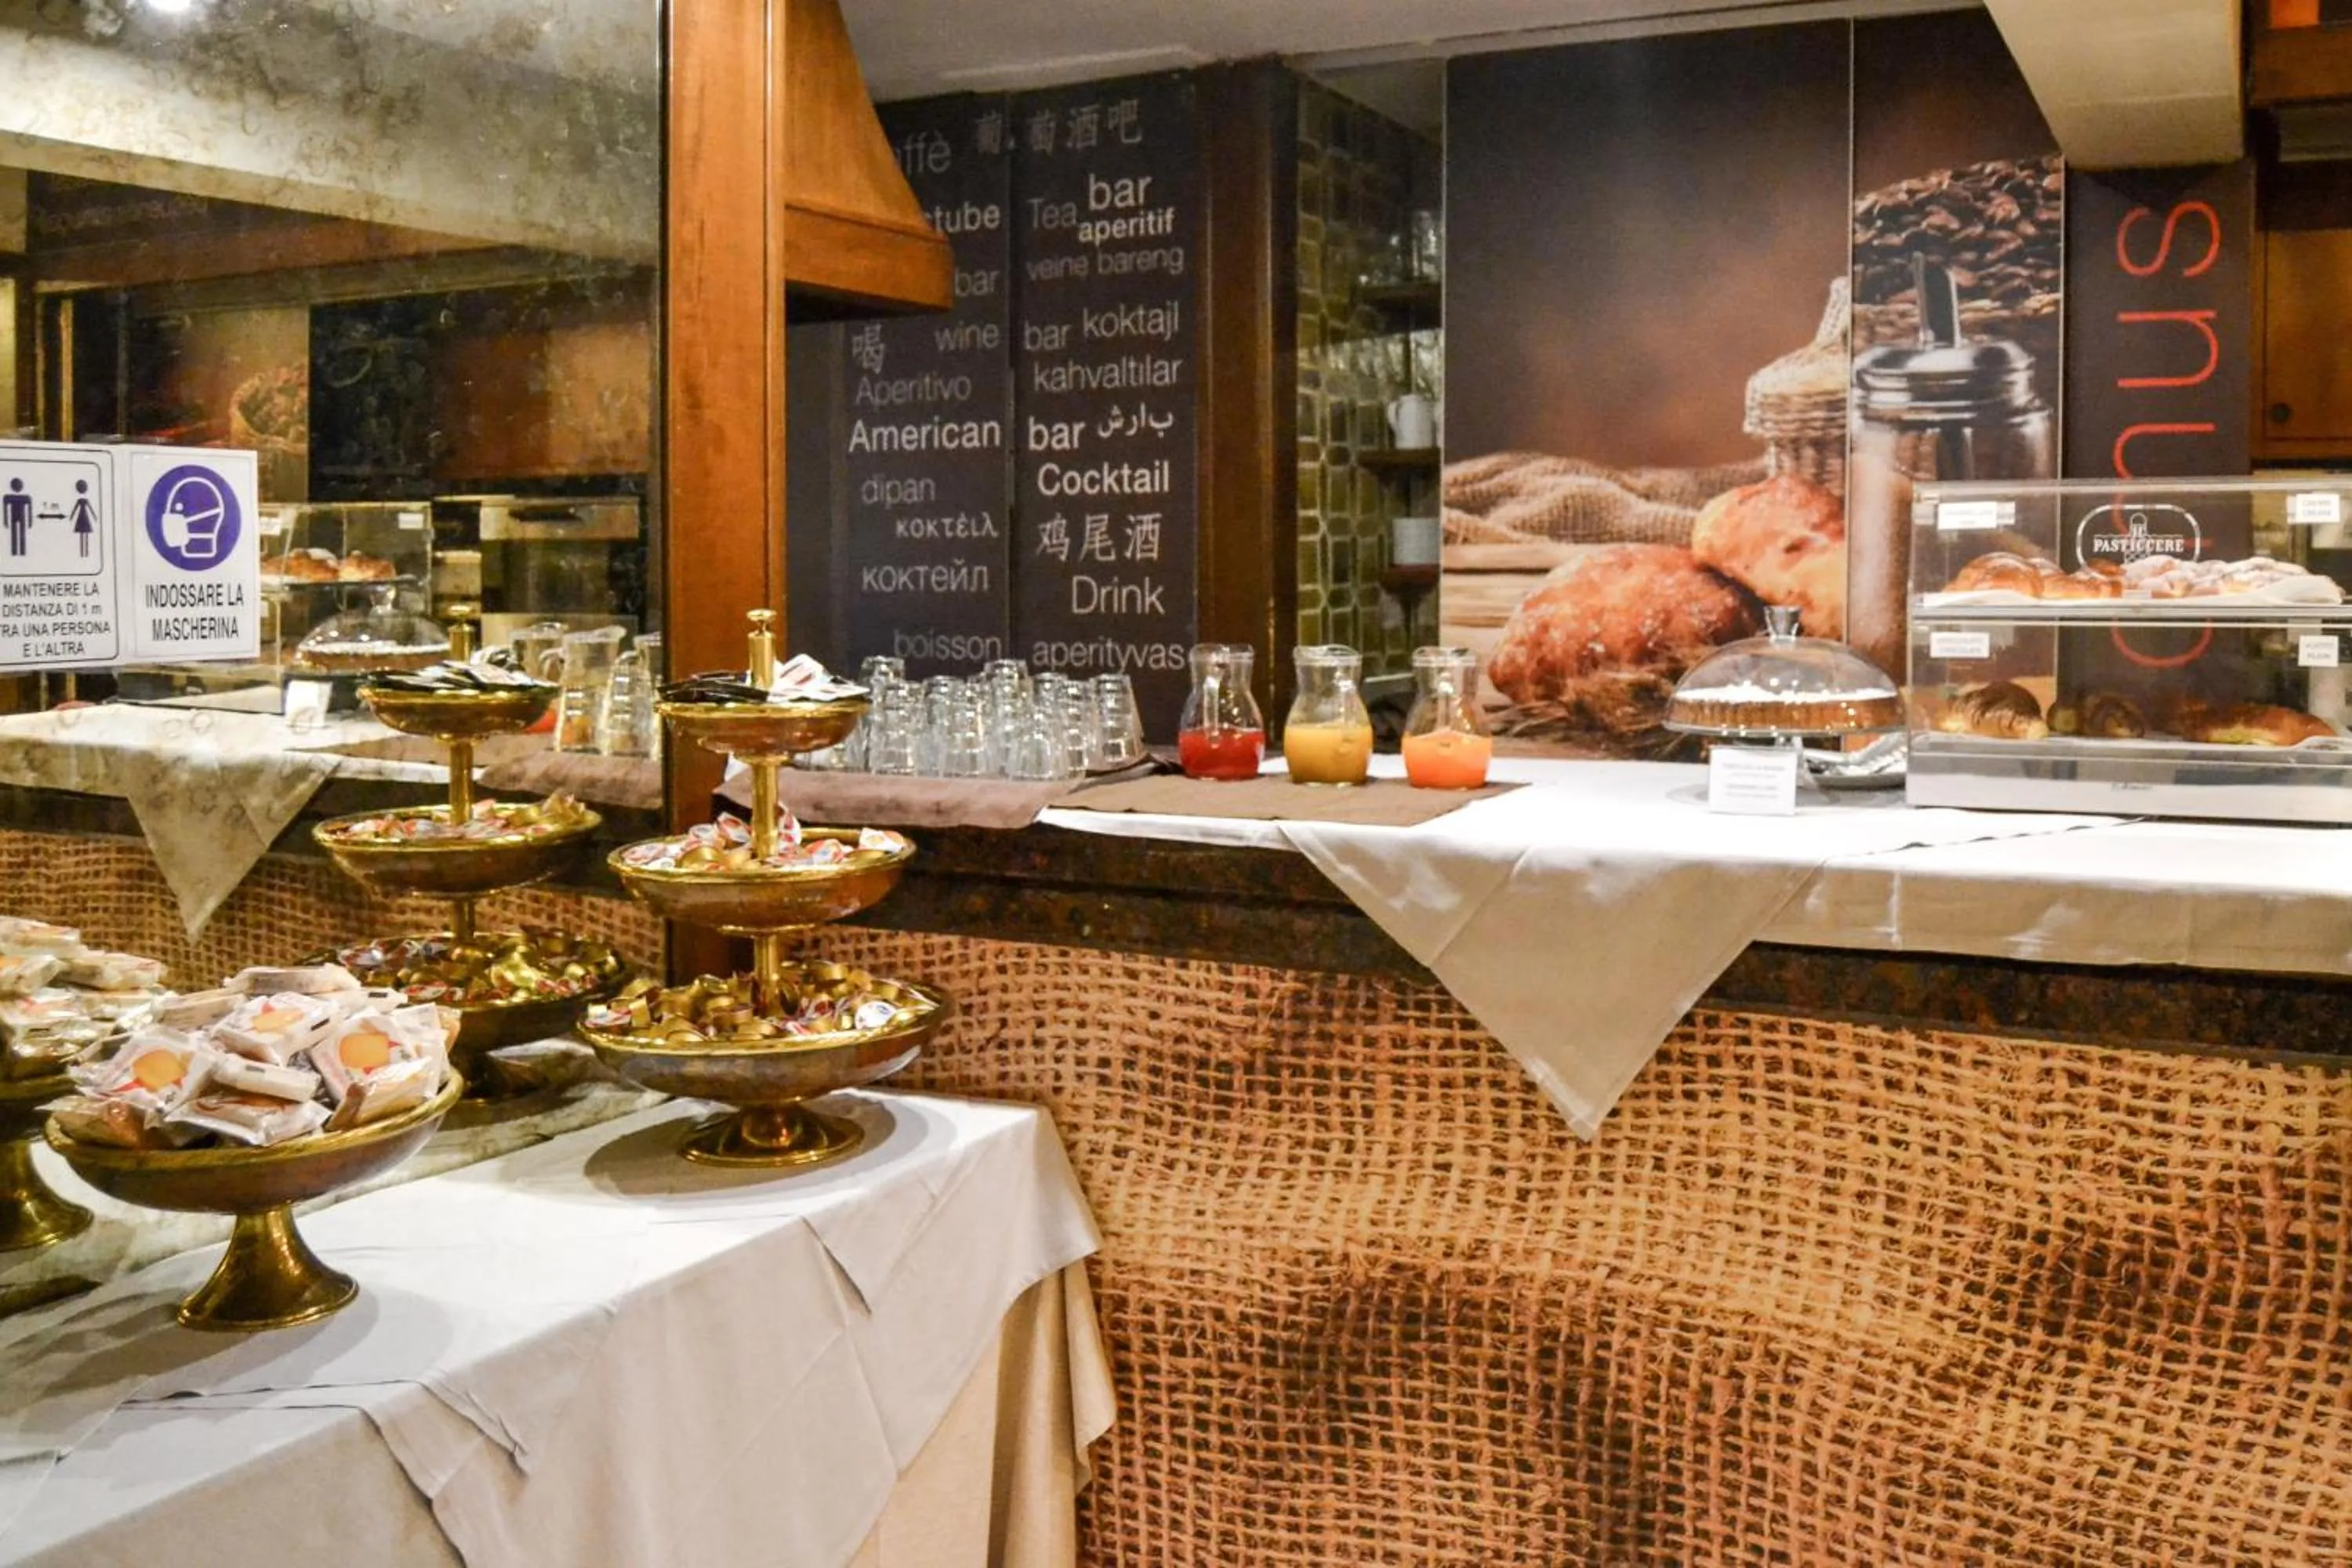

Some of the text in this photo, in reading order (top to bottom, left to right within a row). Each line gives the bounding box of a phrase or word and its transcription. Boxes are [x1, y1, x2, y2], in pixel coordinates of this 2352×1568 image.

[900, 131, 951, 174] ffè
[1089, 173, 1152, 212] bar
[925, 201, 1000, 234] tube
[1027, 198, 1077, 230] Tea
[1079, 206, 1175, 247] aperitif
[954, 267, 1000, 297] bar
[935, 320, 1072, 351] wine bar
[1083, 301, 1179, 341] koktajl
[855, 371, 972, 412] Aperitivo
[848, 415, 1086, 453] American bar
[862, 472, 935, 510] dipan
[1037, 459, 1170, 496] Cocktail
[1036, 512, 1163, 564] 鸡尾酒
[2092, 539, 2185, 553] PASTICCERE
[3, 583, 100, 597] MANTENERE LA
[145, 584, 245, 608] INDOSSARE LA
[1071, 575, 1165, 615] Drink
[2, 602, 102, 617] DISTANZA DI 1 m
[23, 624, 49, 637] UNA
[53, 621, 111, 637] PERSONA
[152, 616, 240, 641] MASCHERINA
[894, 629, 1003, 659] boisson
[23, 641, 85, 657] E L'ALTRA
[1033, 636, 1185, 672] aperityvas
